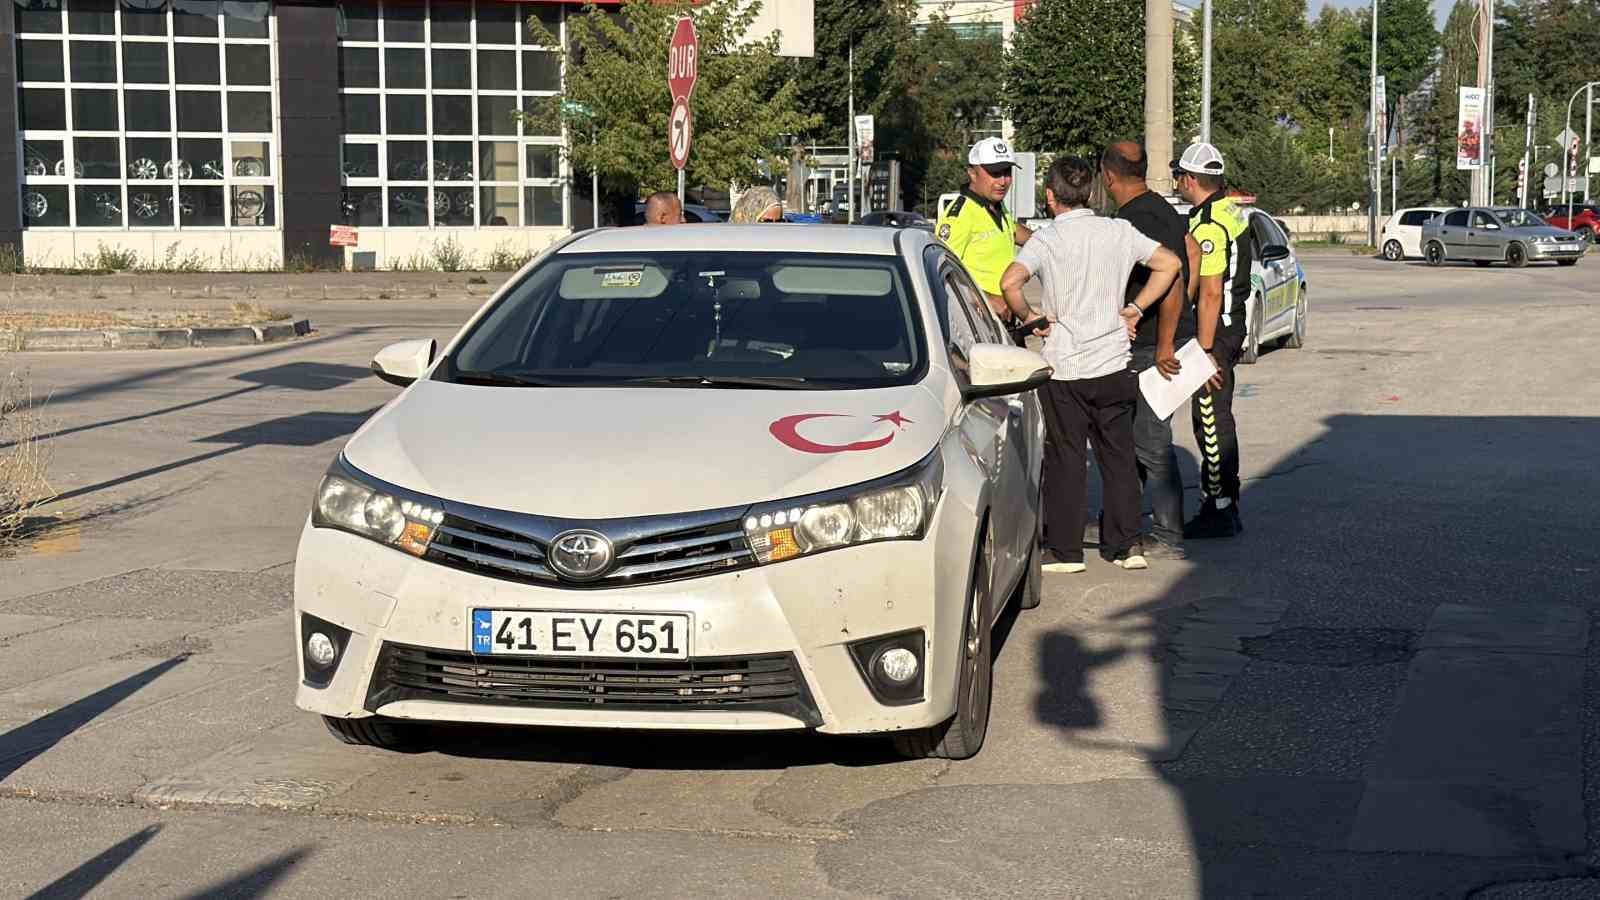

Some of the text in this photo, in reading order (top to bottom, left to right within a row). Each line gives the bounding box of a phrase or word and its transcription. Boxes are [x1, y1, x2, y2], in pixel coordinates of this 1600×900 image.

[671, 44, 695, 80] DUR
[477, 635, 490, 645] TR
[495, 616, 680, 654] 41 EY 651
